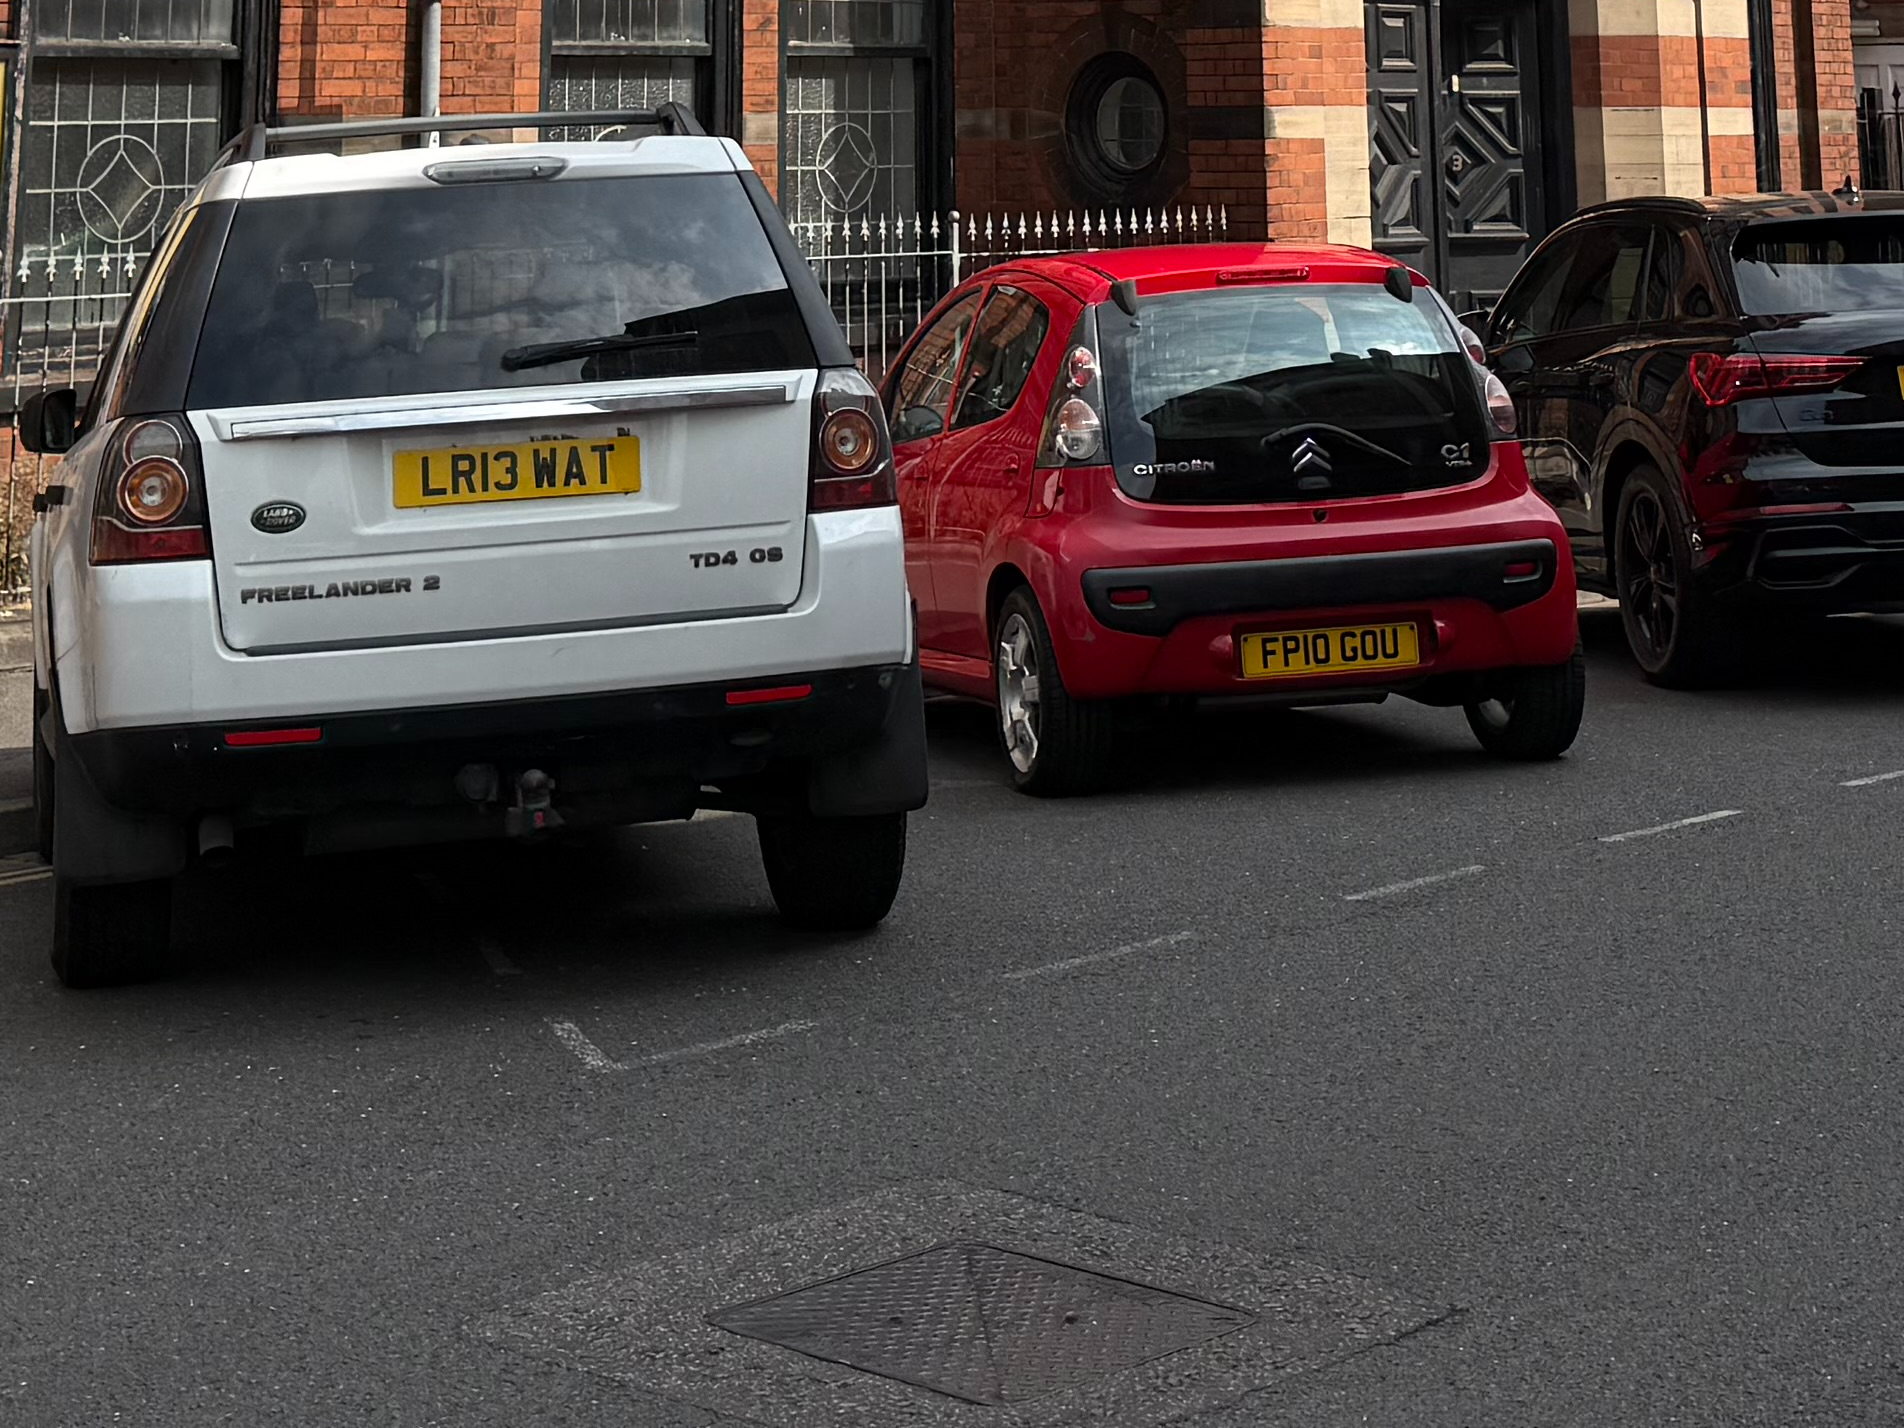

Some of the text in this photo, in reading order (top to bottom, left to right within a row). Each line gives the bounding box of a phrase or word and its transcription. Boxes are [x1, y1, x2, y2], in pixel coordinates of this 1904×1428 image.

[1452, 154, 1463, 171] 3
[1440, 442, 1470, 459] C1
[421, 443, 615, 497] LR13 WAT
[1133, 458, 1215, 475] CITROËN
[689, 550, 738, 569] TD4
[240, 574, 441, 604] FREELANDER 2
[1261, 627, 1400, 669] FP10 GOU
